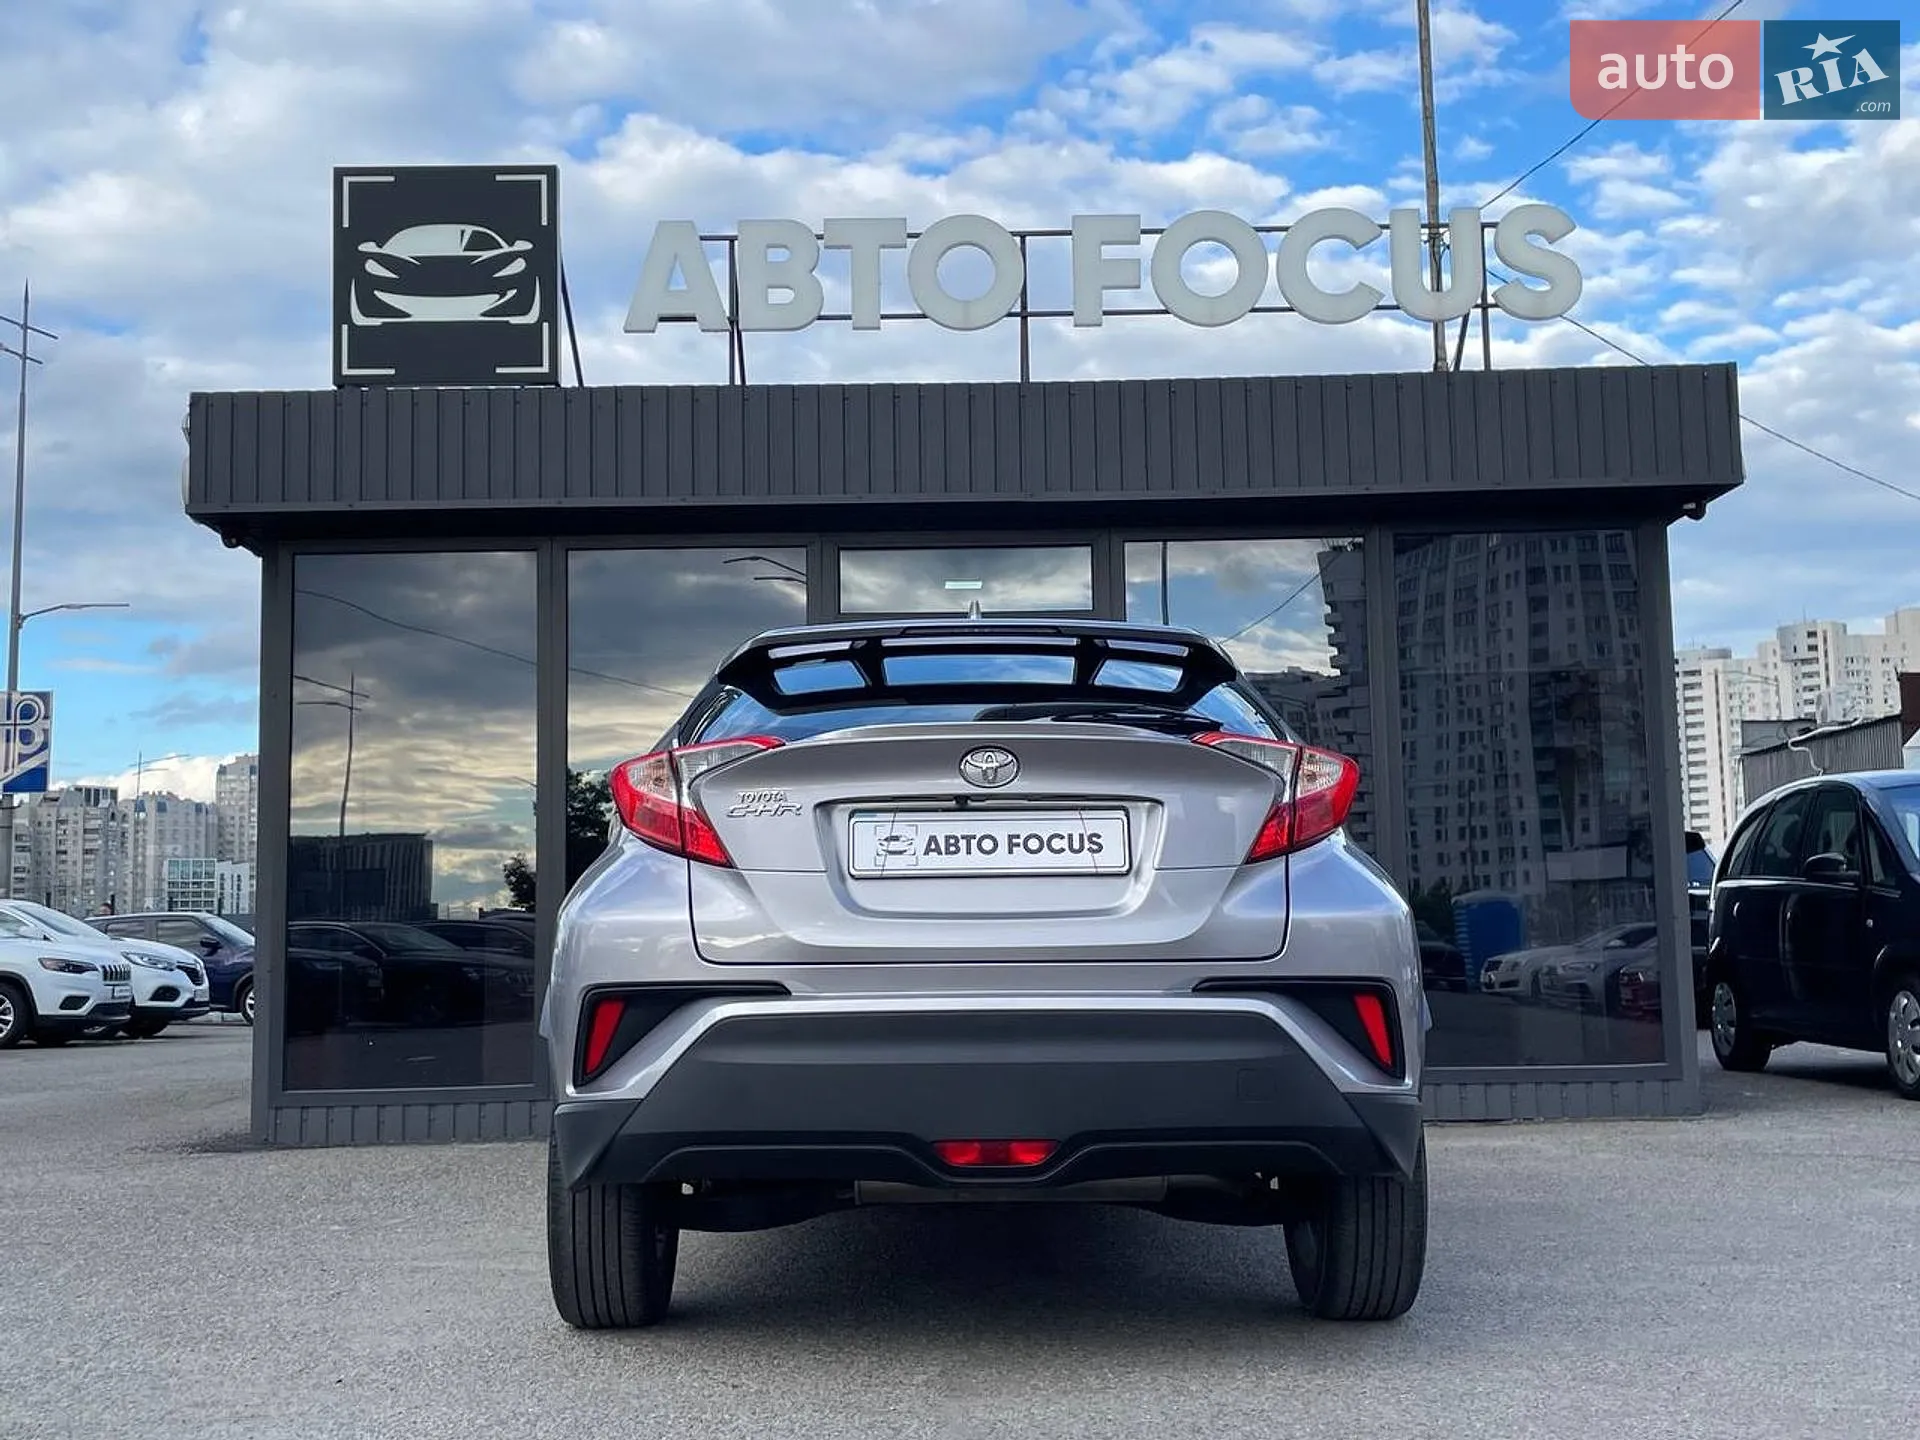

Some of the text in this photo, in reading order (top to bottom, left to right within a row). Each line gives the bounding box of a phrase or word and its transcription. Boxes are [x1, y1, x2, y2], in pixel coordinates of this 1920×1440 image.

[623, 204, 1583, 332] АВТО FOCUS
[736, 790, 788, 804] TOYOTA
[923, 832, 1104, 856] АВТО FOCUS
